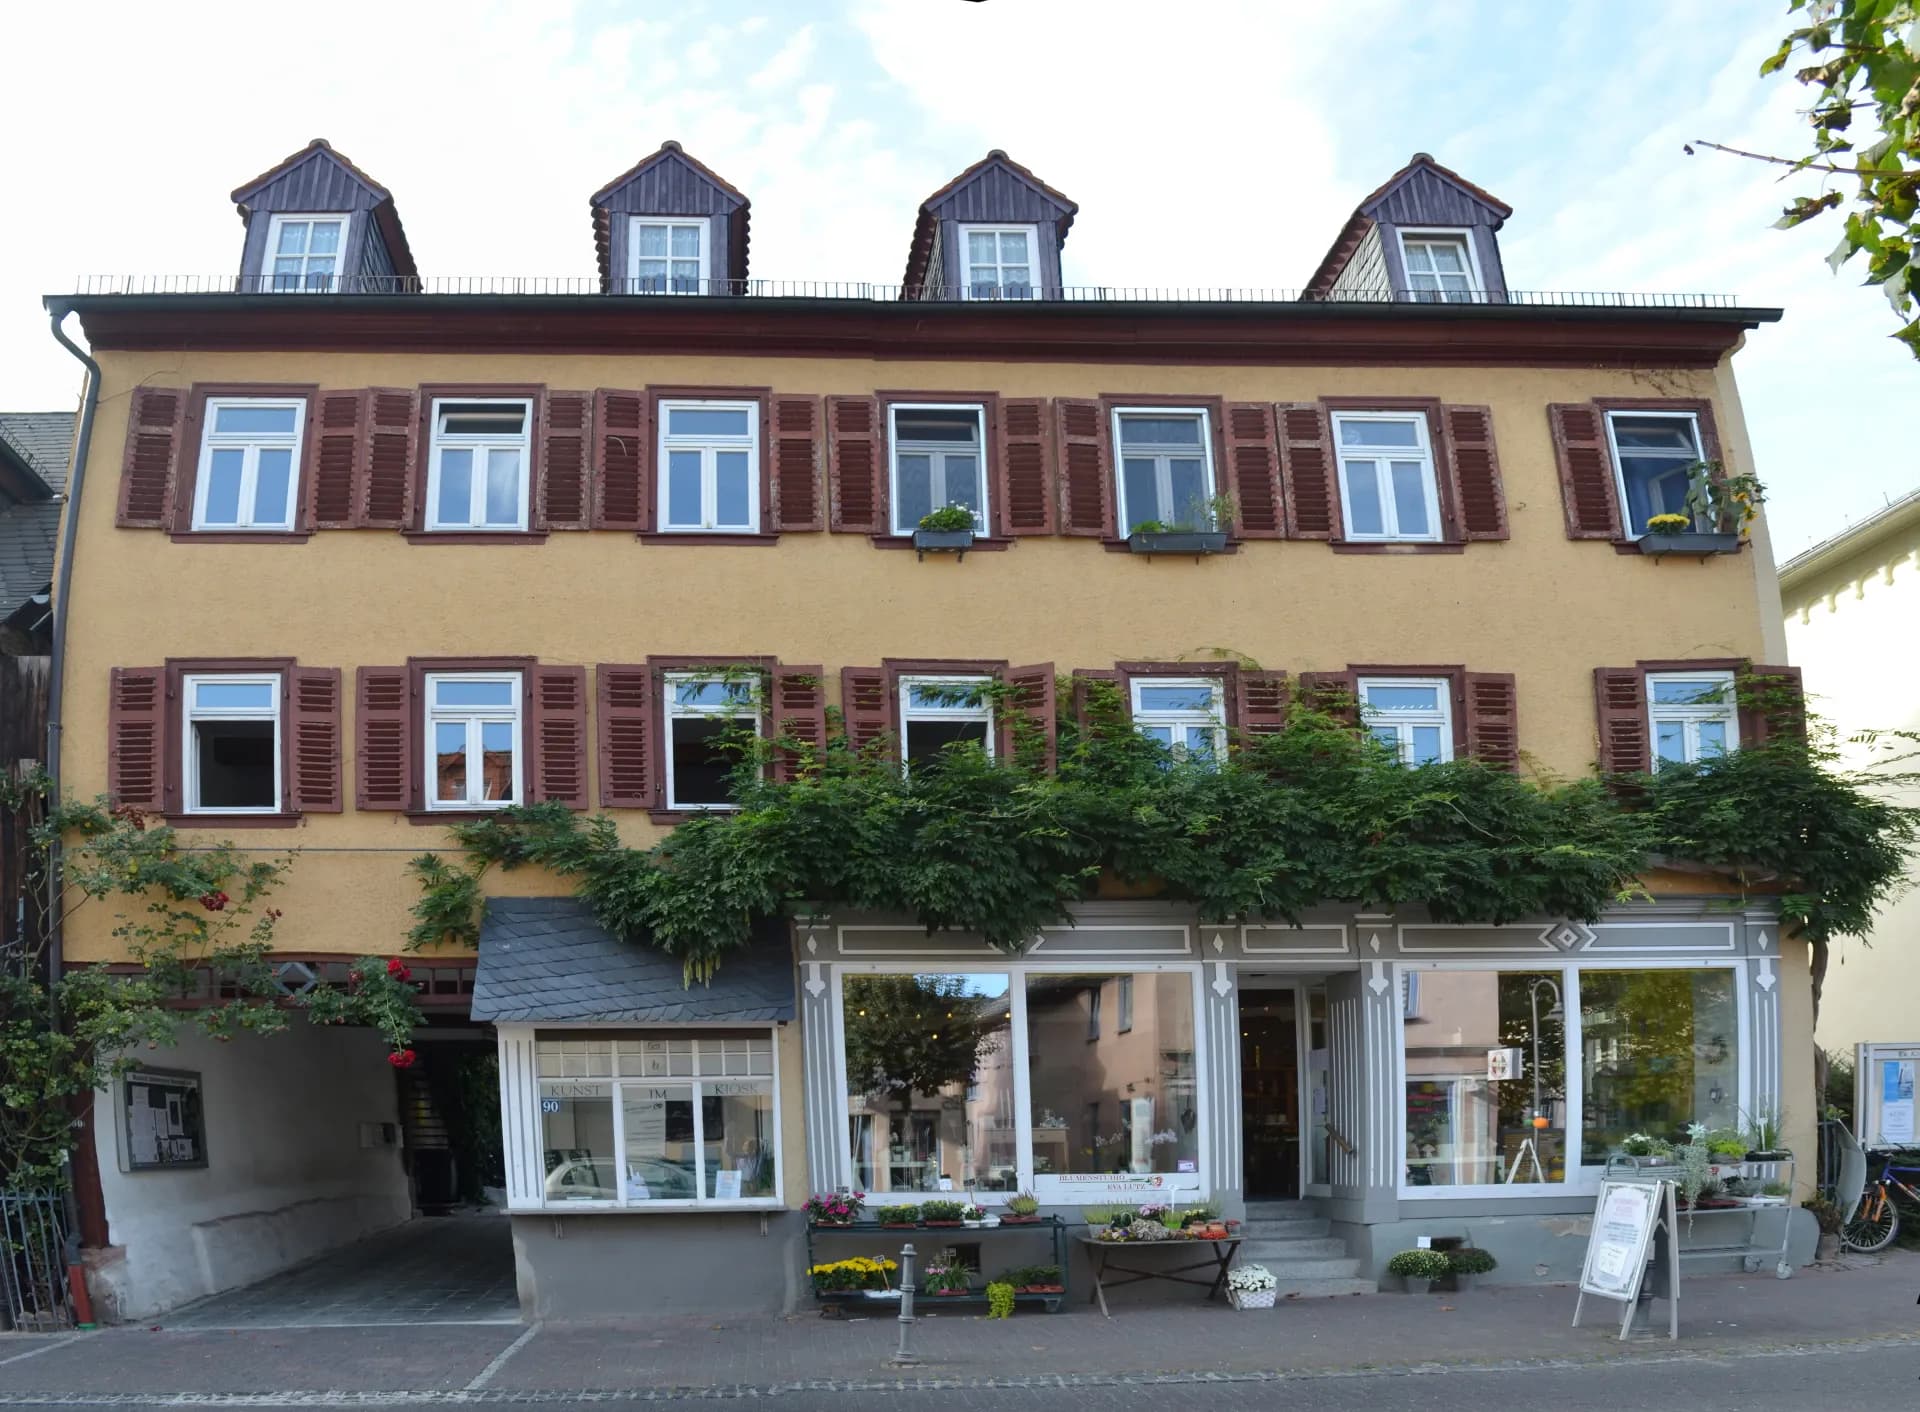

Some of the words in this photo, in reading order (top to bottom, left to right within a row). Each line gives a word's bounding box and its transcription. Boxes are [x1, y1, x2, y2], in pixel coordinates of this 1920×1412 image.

[551, 1085, 602, 1097] KUNST
[648, 1088, 667, 1099] IM
[543, 1101, 558, 1113] 90
